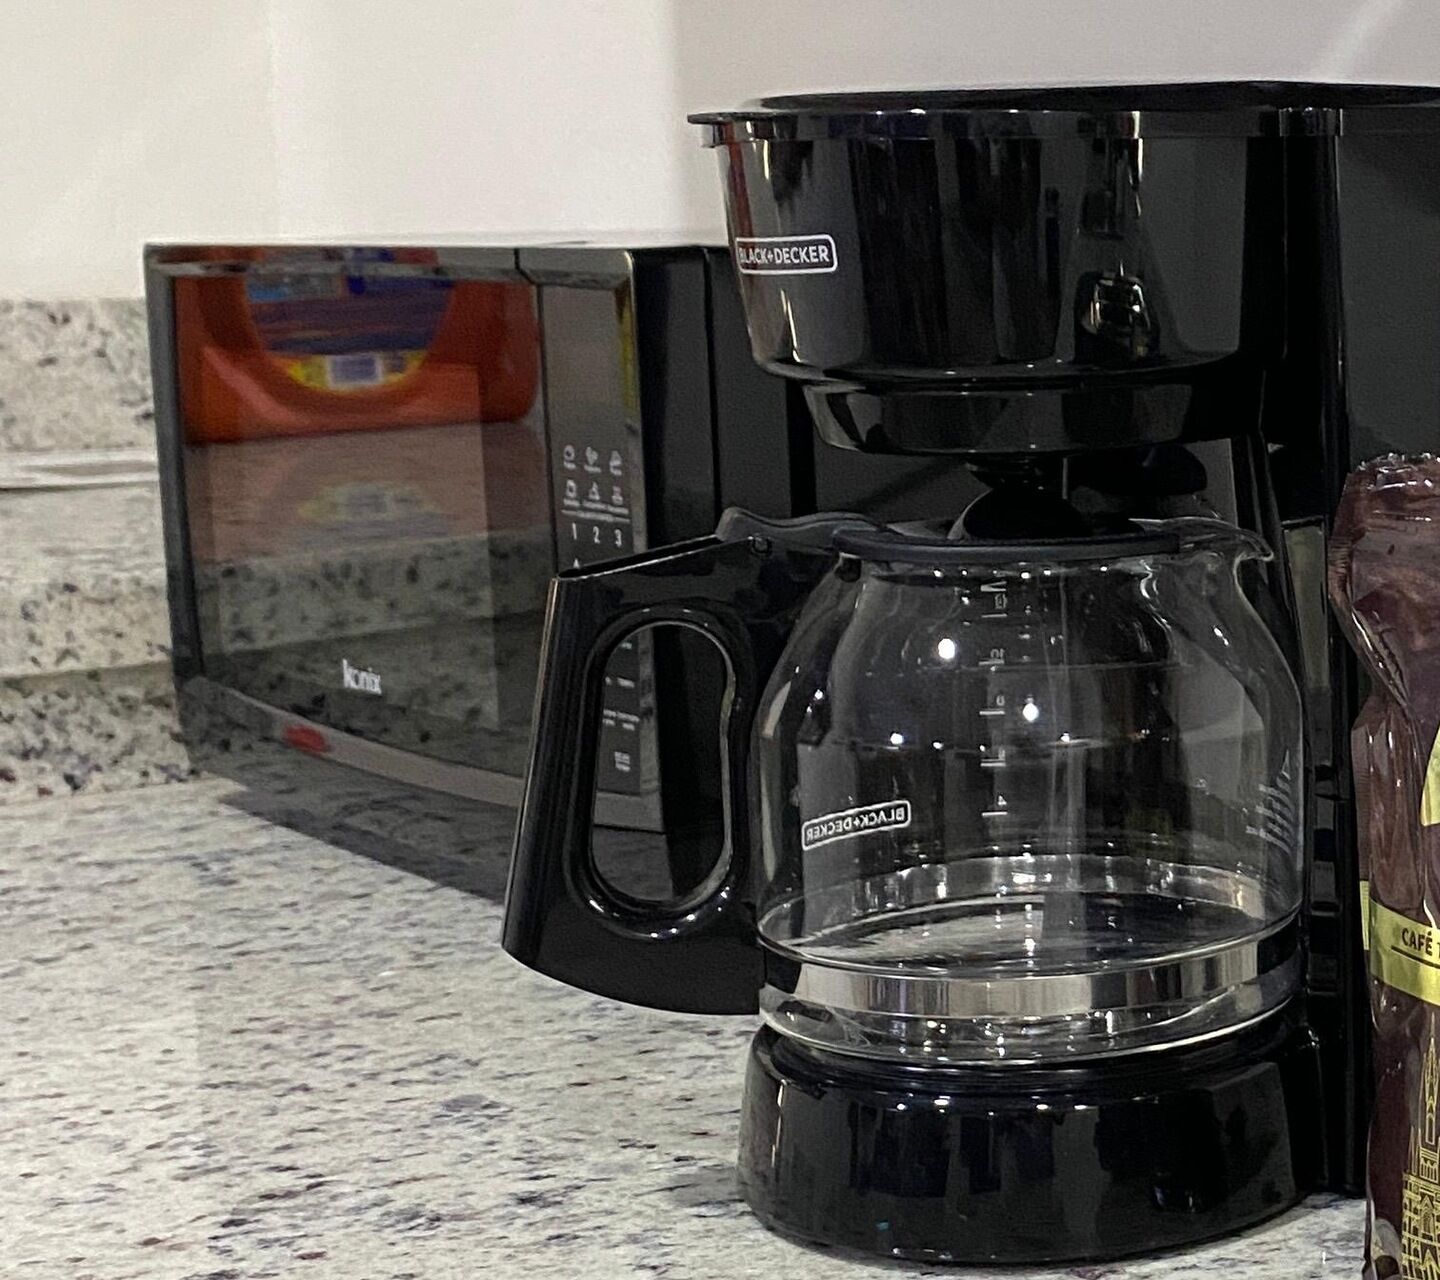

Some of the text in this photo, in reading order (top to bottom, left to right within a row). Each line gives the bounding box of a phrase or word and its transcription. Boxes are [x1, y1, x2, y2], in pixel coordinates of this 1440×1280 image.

[738, 245, 830, 265] BLACK+DECKER
[592, 526, 600, 544] 2
[1401, 929, 1433, 956] CAFÉ
